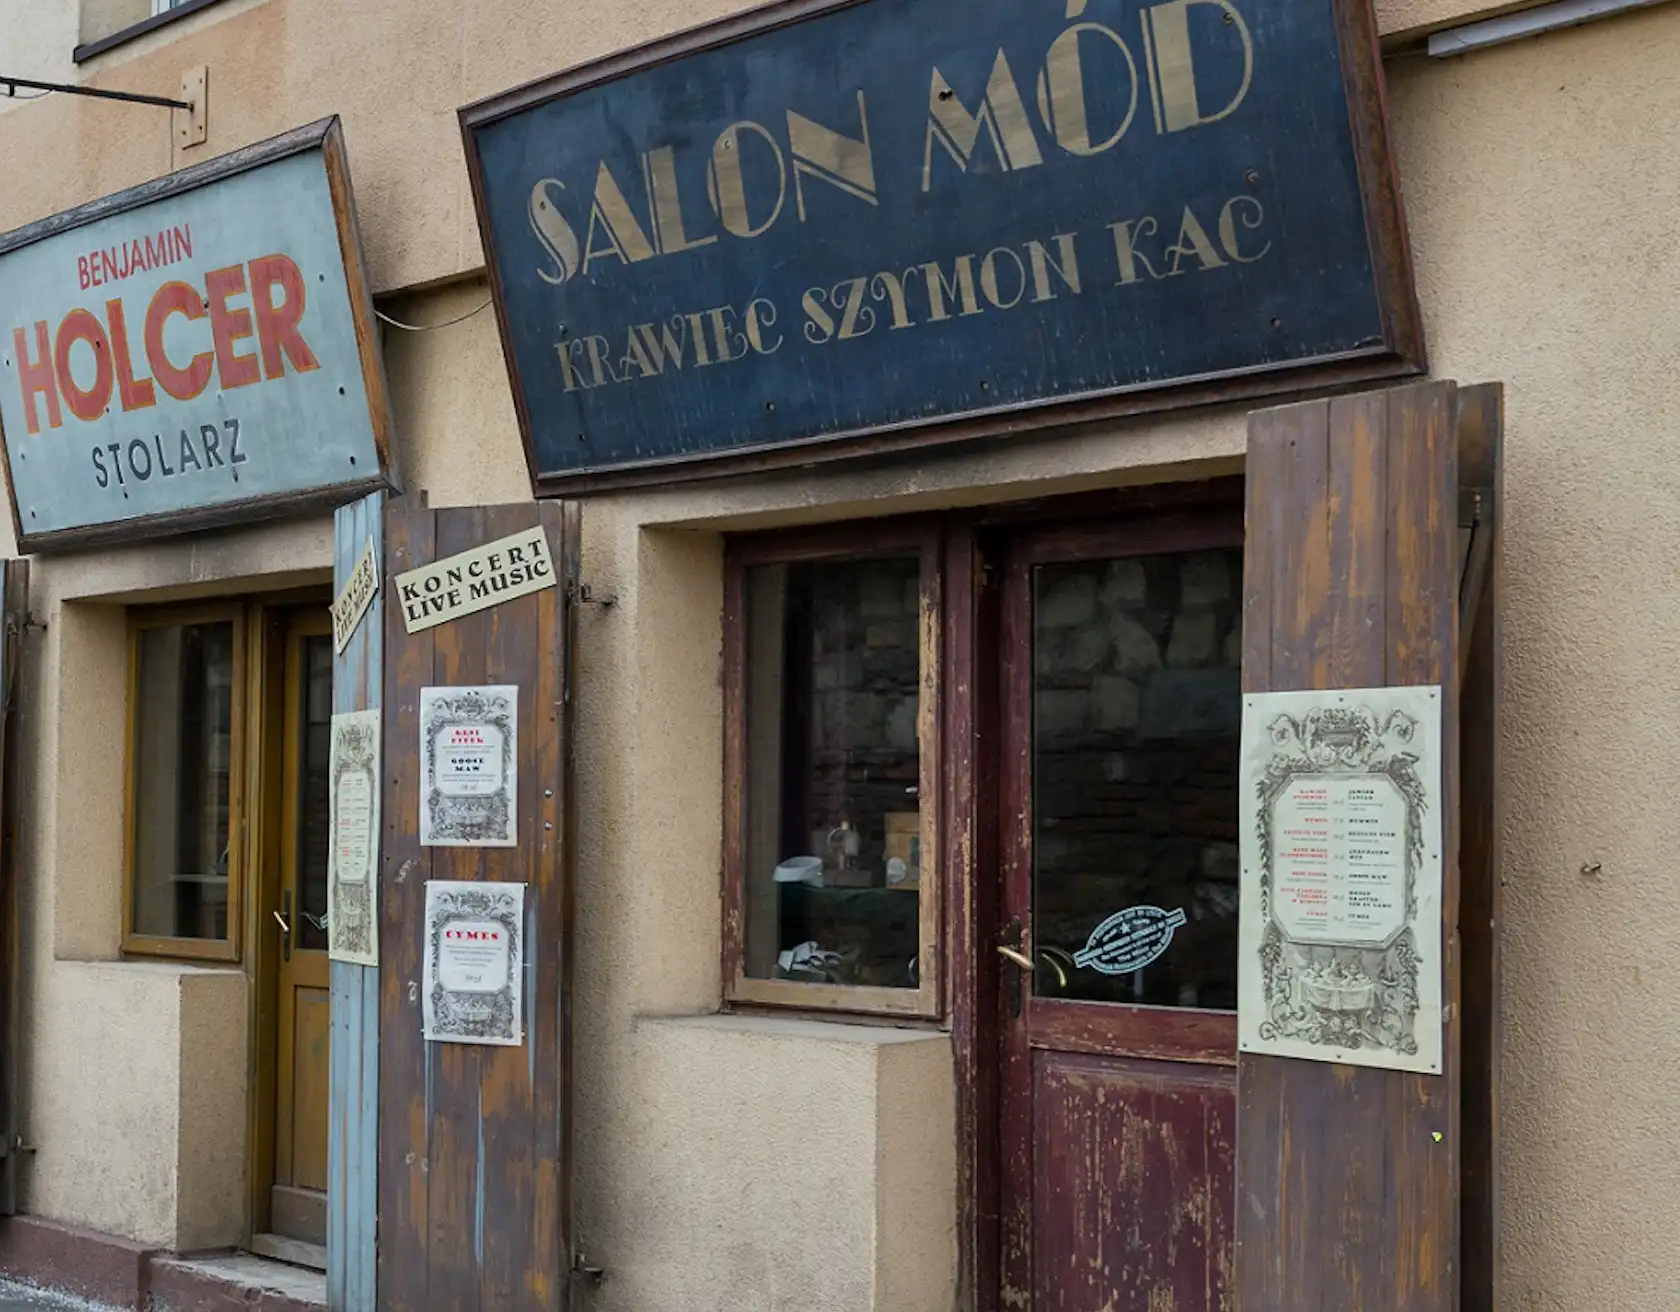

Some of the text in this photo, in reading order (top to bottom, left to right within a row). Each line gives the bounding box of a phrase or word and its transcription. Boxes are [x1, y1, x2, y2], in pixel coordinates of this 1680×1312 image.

[529, 88, 878, 286] SALON
[77, 223, 194, 290] BENJAMIN
[553, 195, 1276, 393] KRAWIEC SZYMON KAC
[13, 253, 322, 435] HOLCER
[91, 418, 247, 488] STOLARZ
[402, 540, 542, 601] KONCERT
[446, 929, 500, 941] CYMES
